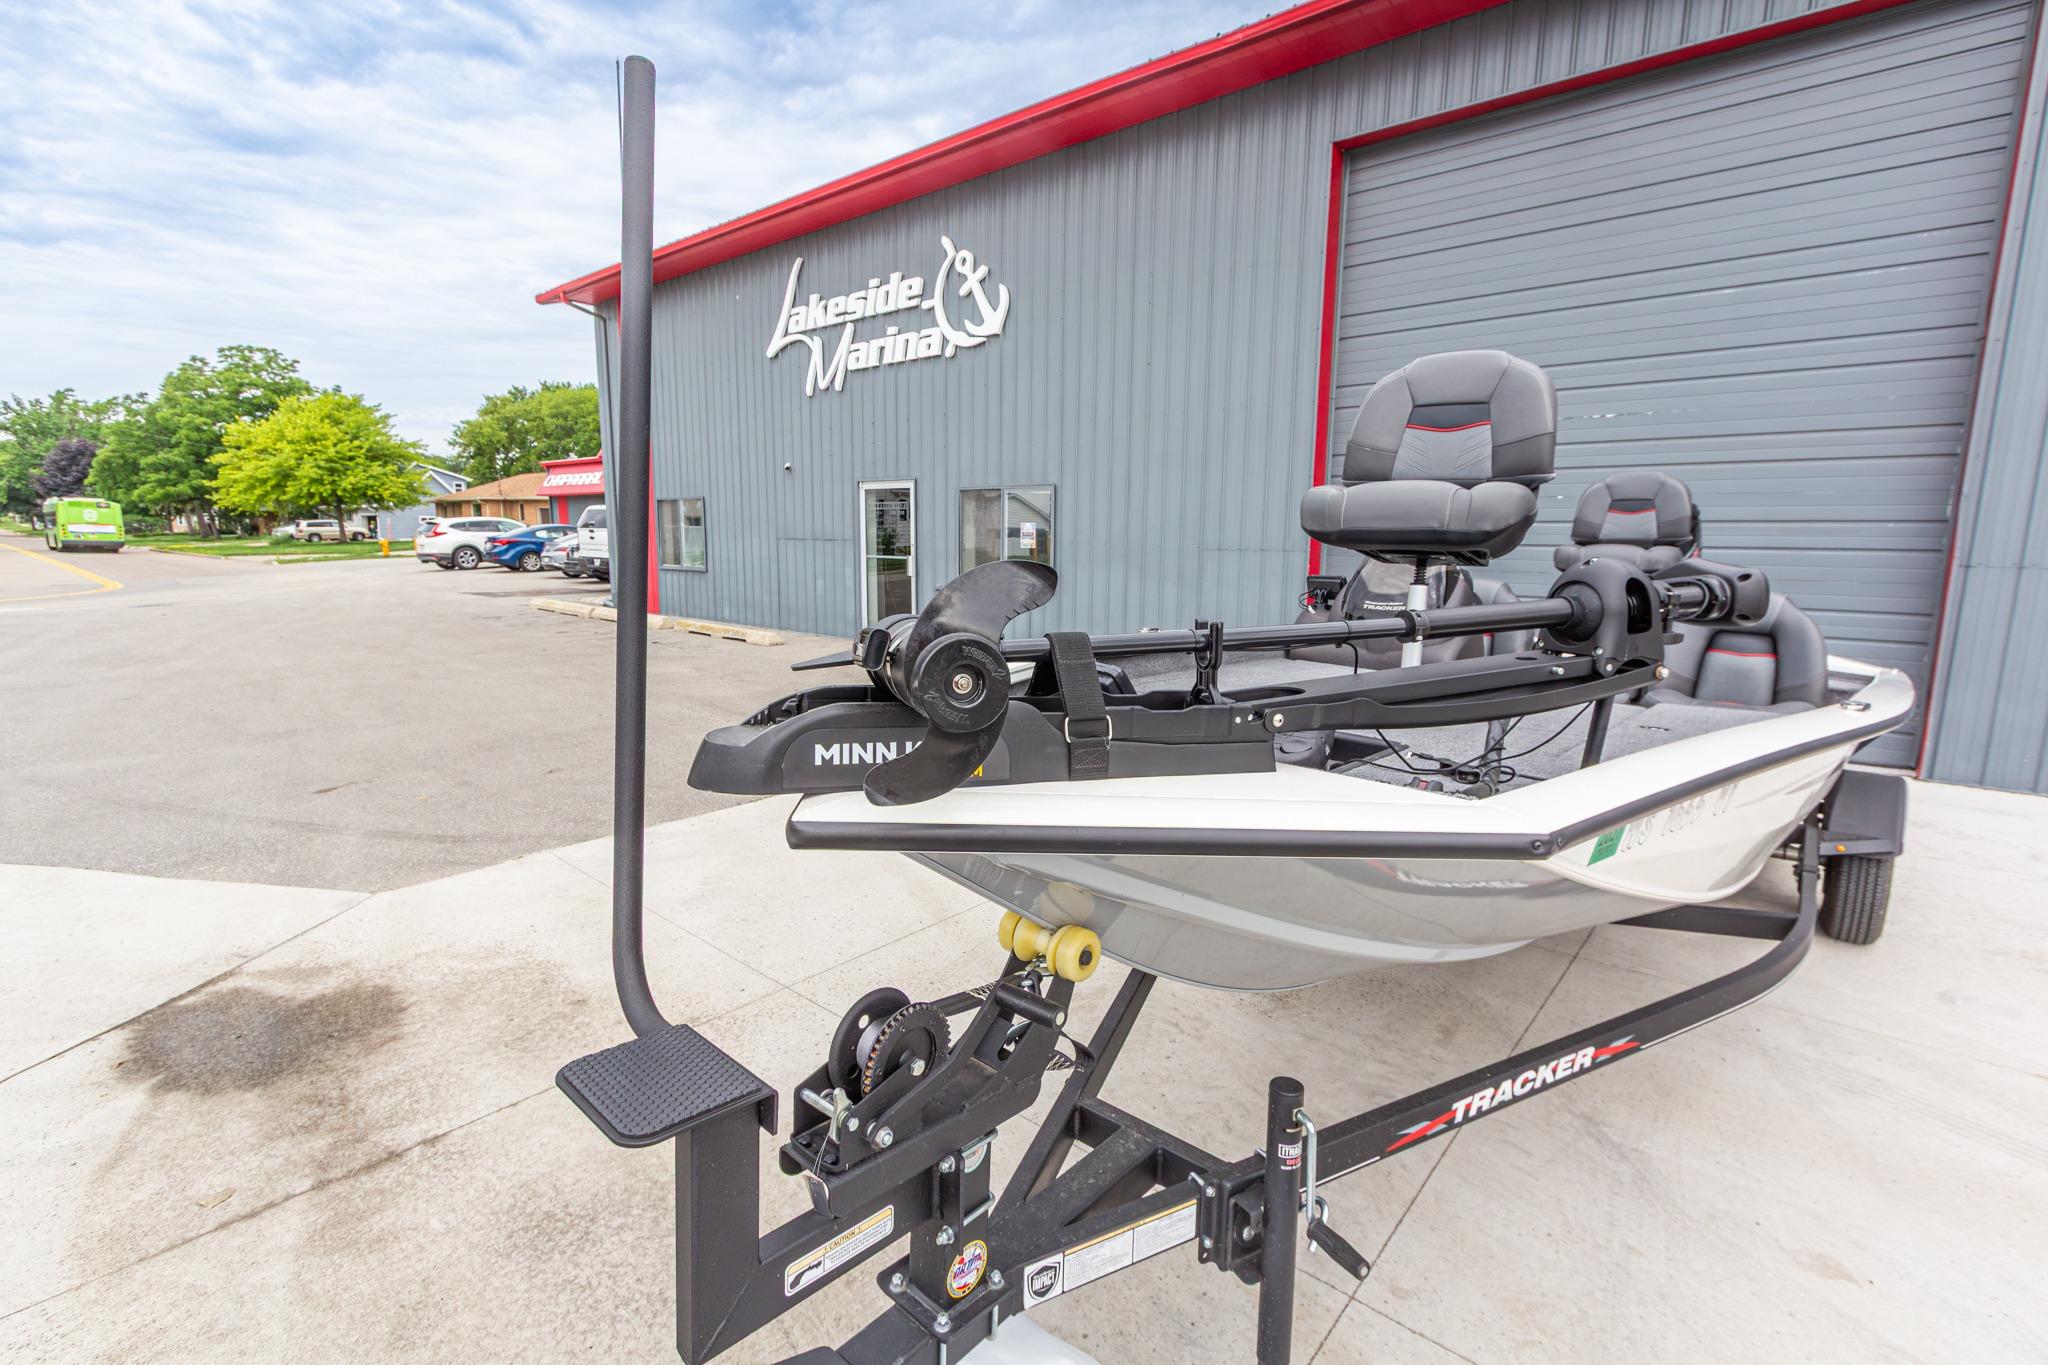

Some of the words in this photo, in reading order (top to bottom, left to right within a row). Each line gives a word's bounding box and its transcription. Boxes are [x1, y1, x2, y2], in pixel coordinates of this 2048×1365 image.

[766, 256, 925, 359] Lakeside
[805, 321, 944, 397] Marina
[814, 741, 897, 766] MINN
[1451, 1046, 1595, 1124] TRACKER
[829, 1230, 856, 1250] CAUTION
[1033, 1271, 1055, 1291] IMPACT
